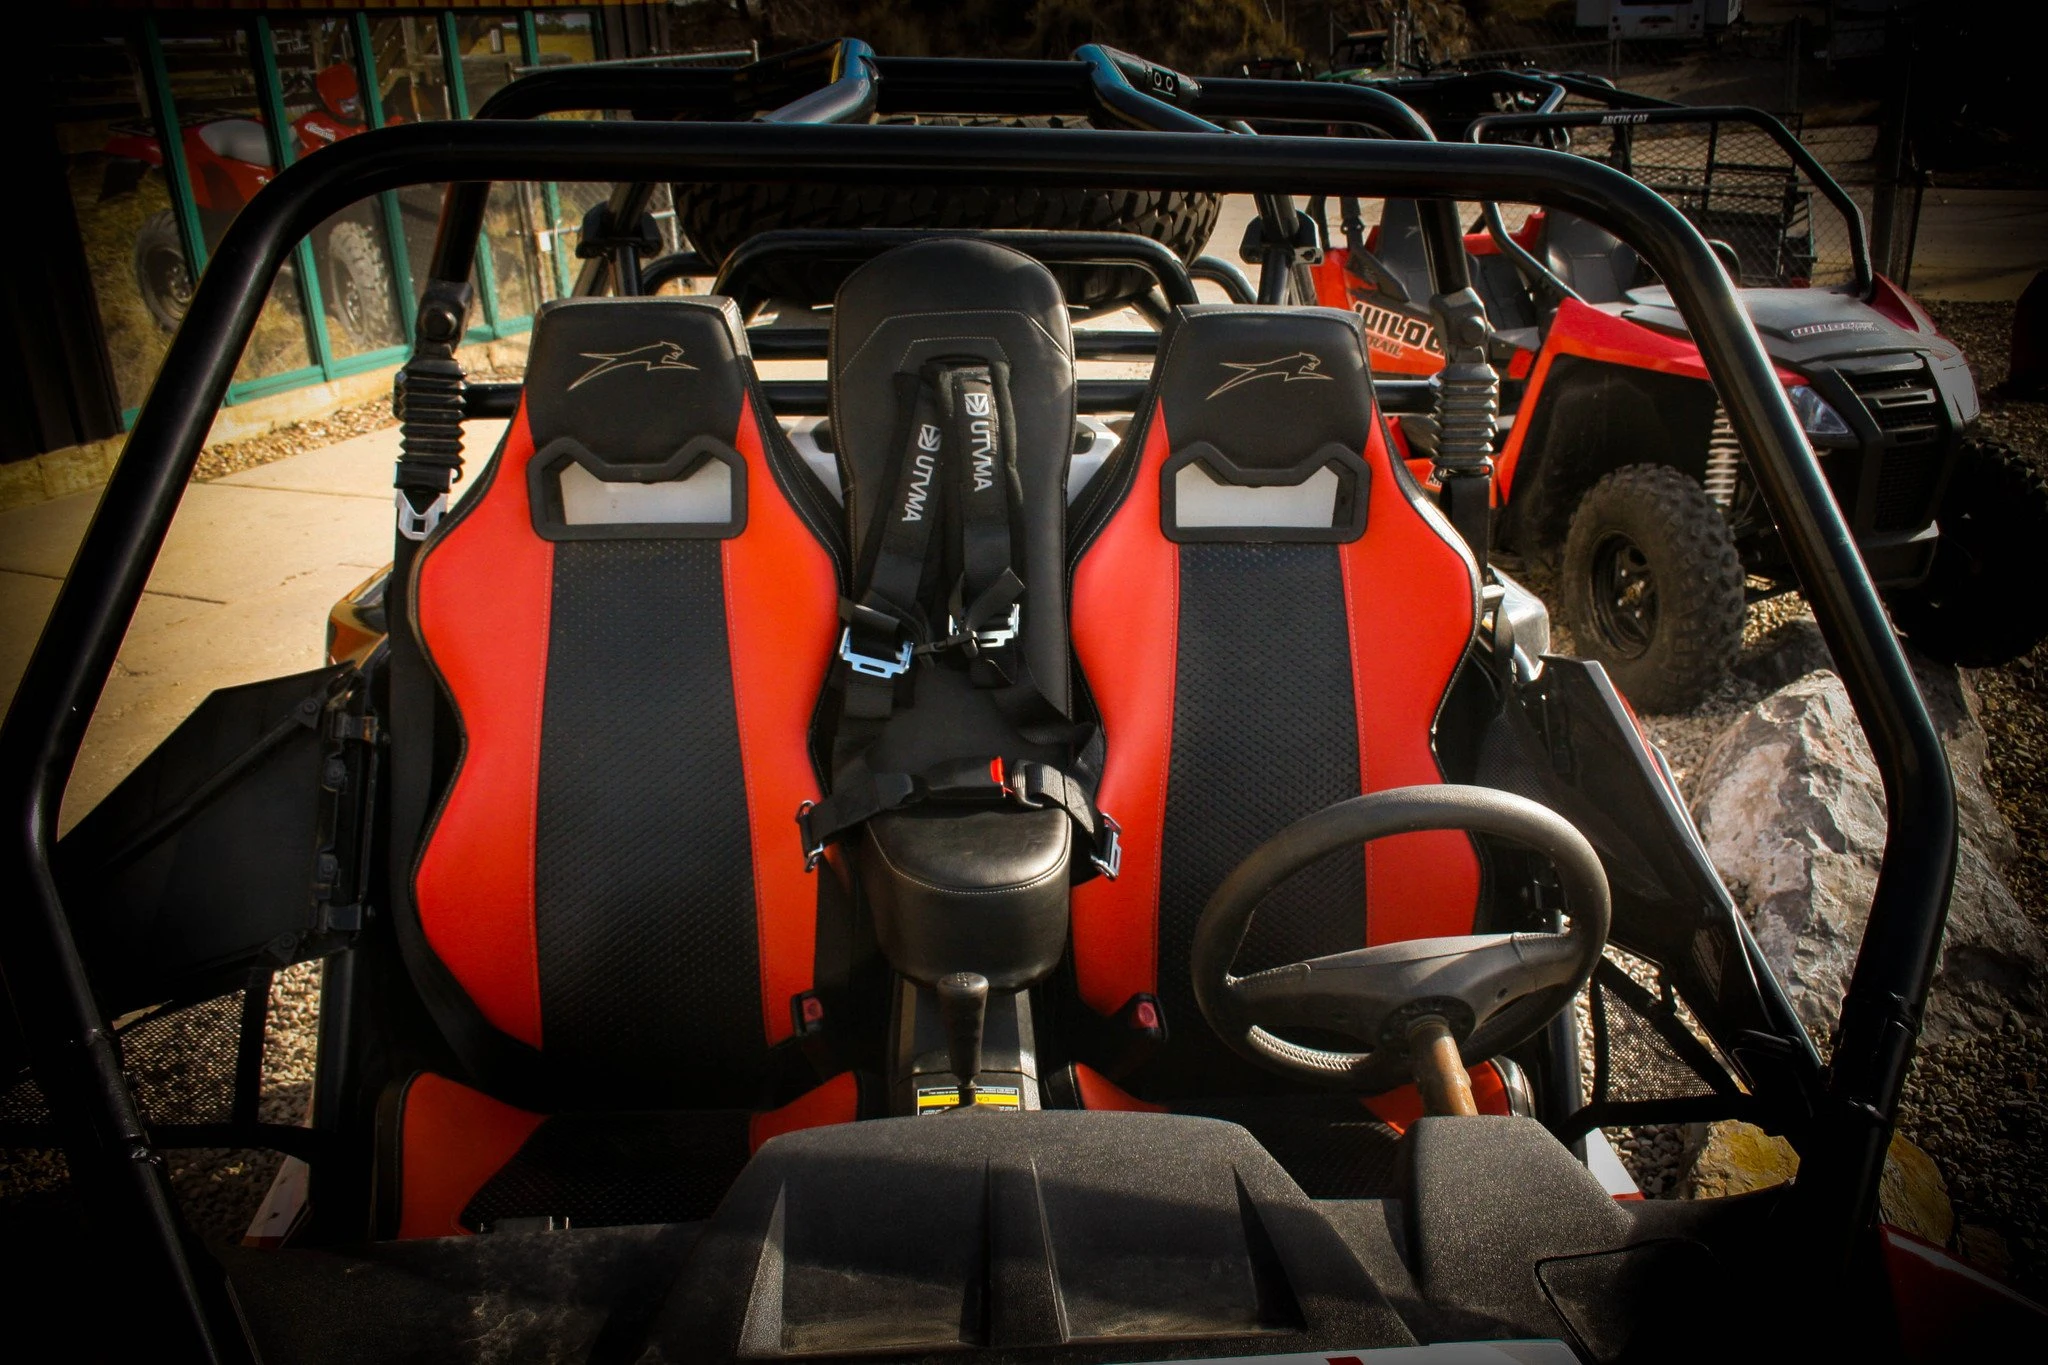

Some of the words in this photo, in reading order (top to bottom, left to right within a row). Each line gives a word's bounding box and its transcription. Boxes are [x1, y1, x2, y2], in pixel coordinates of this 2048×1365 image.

[1600, 114, 1631, 125] ARCTIC
[1633, 113, 1649, 124] CAT
[1353, 300, 1445, 360] WILDC
[970, 421, 993, 493] UTVMA
[902, 456, 935, 522] UTVMA
